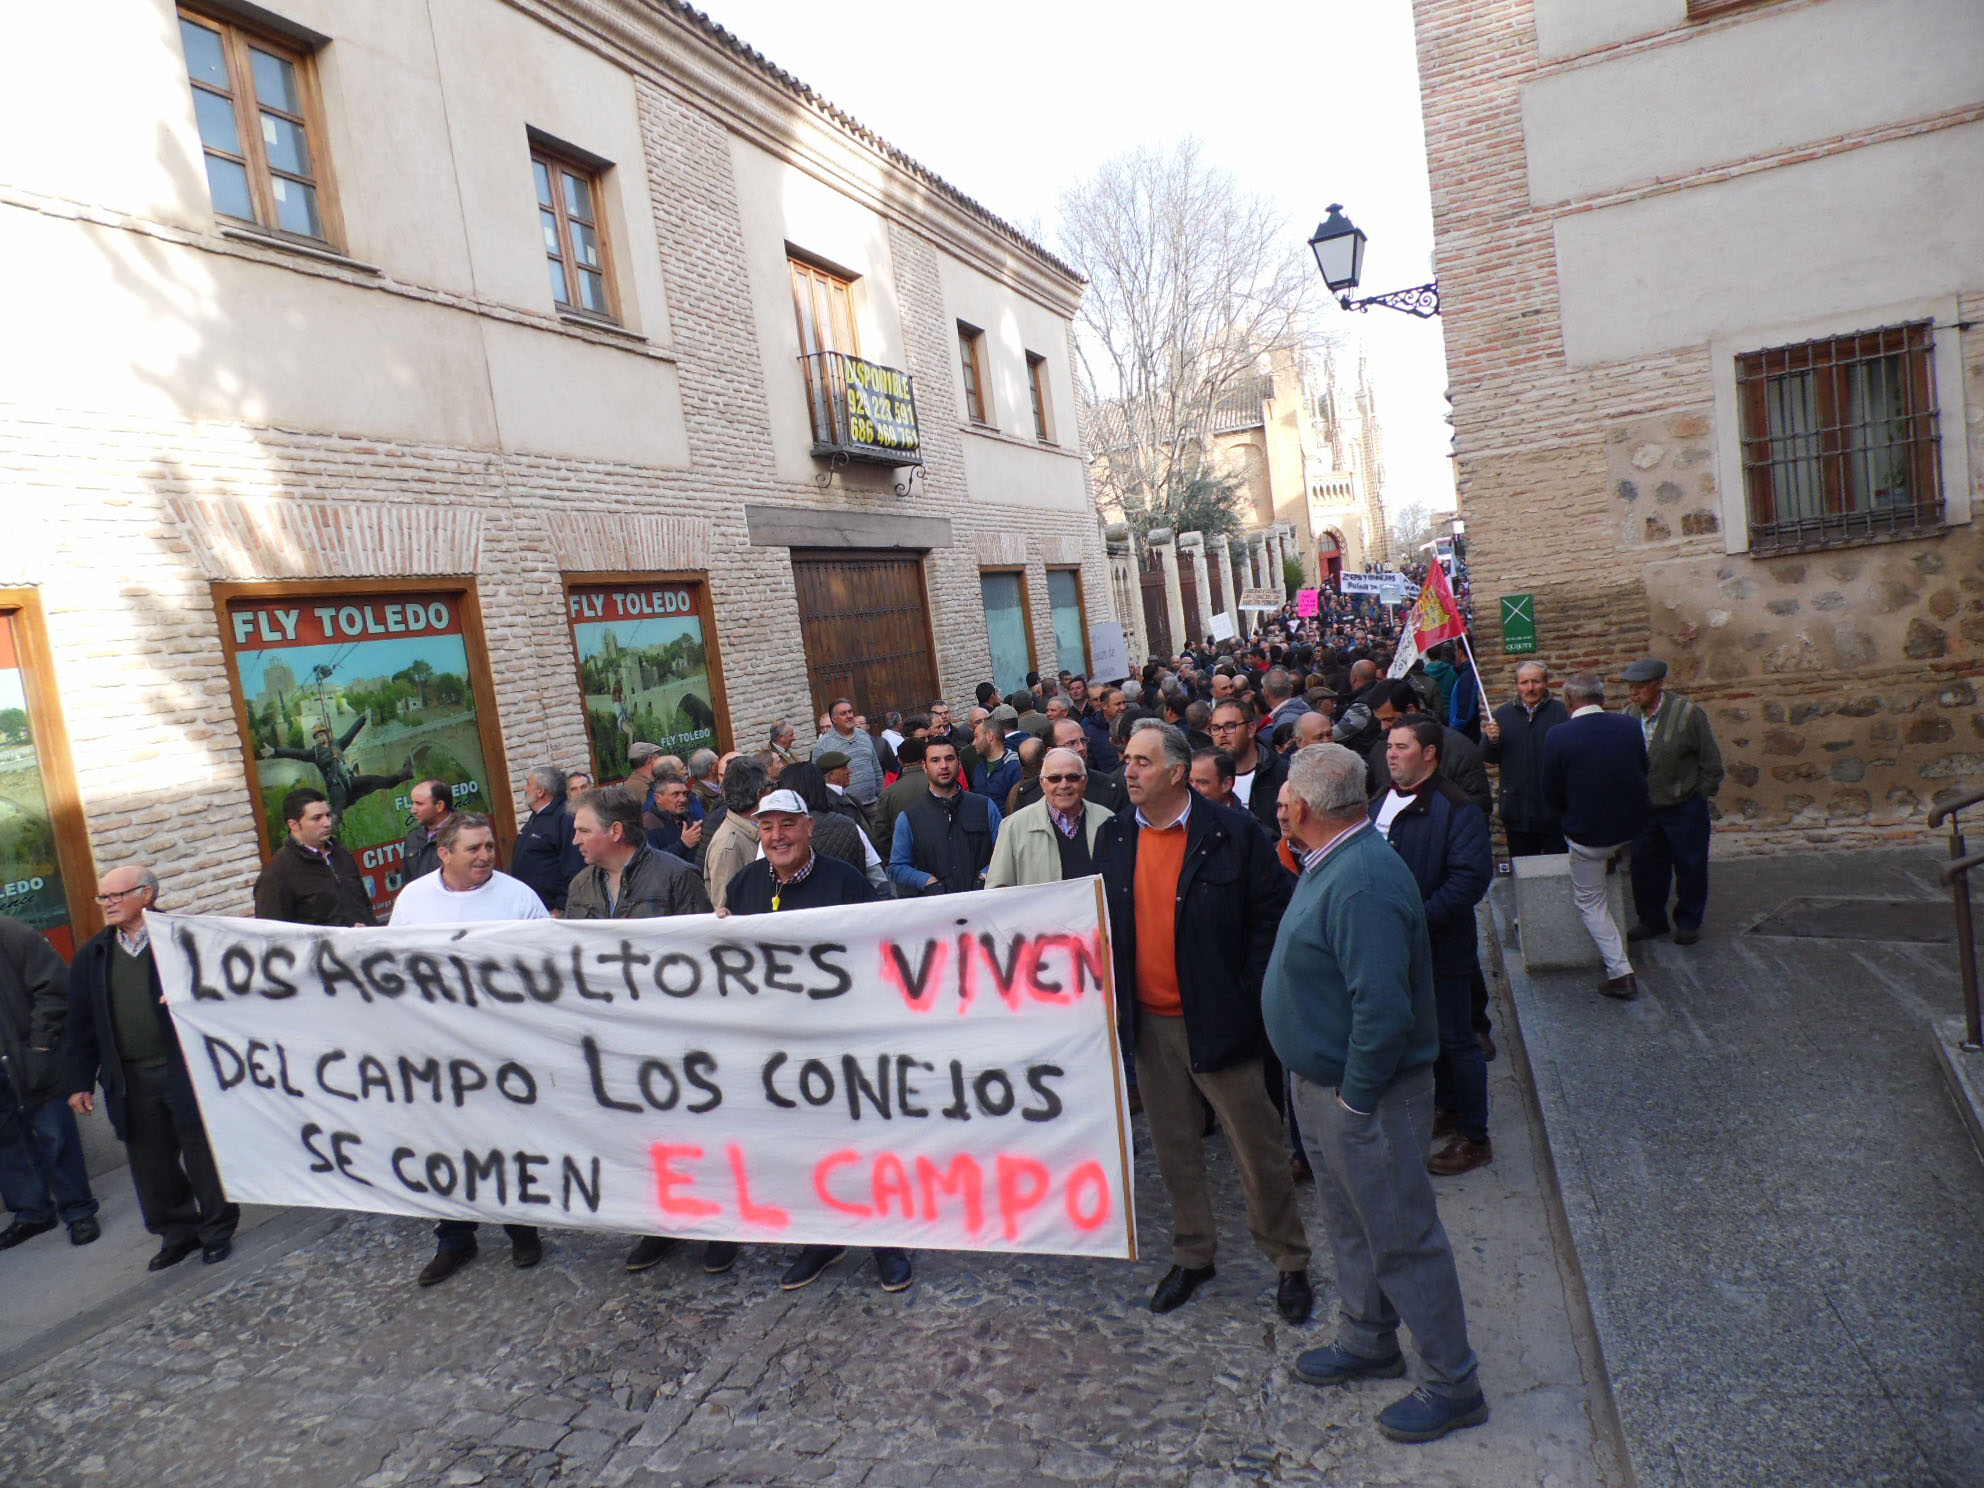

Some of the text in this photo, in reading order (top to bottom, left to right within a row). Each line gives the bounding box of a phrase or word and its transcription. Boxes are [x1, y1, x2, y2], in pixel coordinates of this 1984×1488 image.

[845, 358, 911, 400] DISPONIBLE
[847, 388, 915, 425] 925 223 591
[850, 416, 919, 449] 686 469 761
[231, 601, 451, 644] FLY TOLEDO
[569, 590, 691, 618] FLY TOLEDO
[661, 728, 711, 747] FLY TOLEDO
[394, 795, 413, 811] FL
[178, 918, 1106, 1013] LOS AGRICULTORES VIVEN
[203, 1034, 1065, 1121] DEL CAMPO LOS CONEJOS
[301, 1122, 1111, 1241] SE COMEN EL CAMPO
